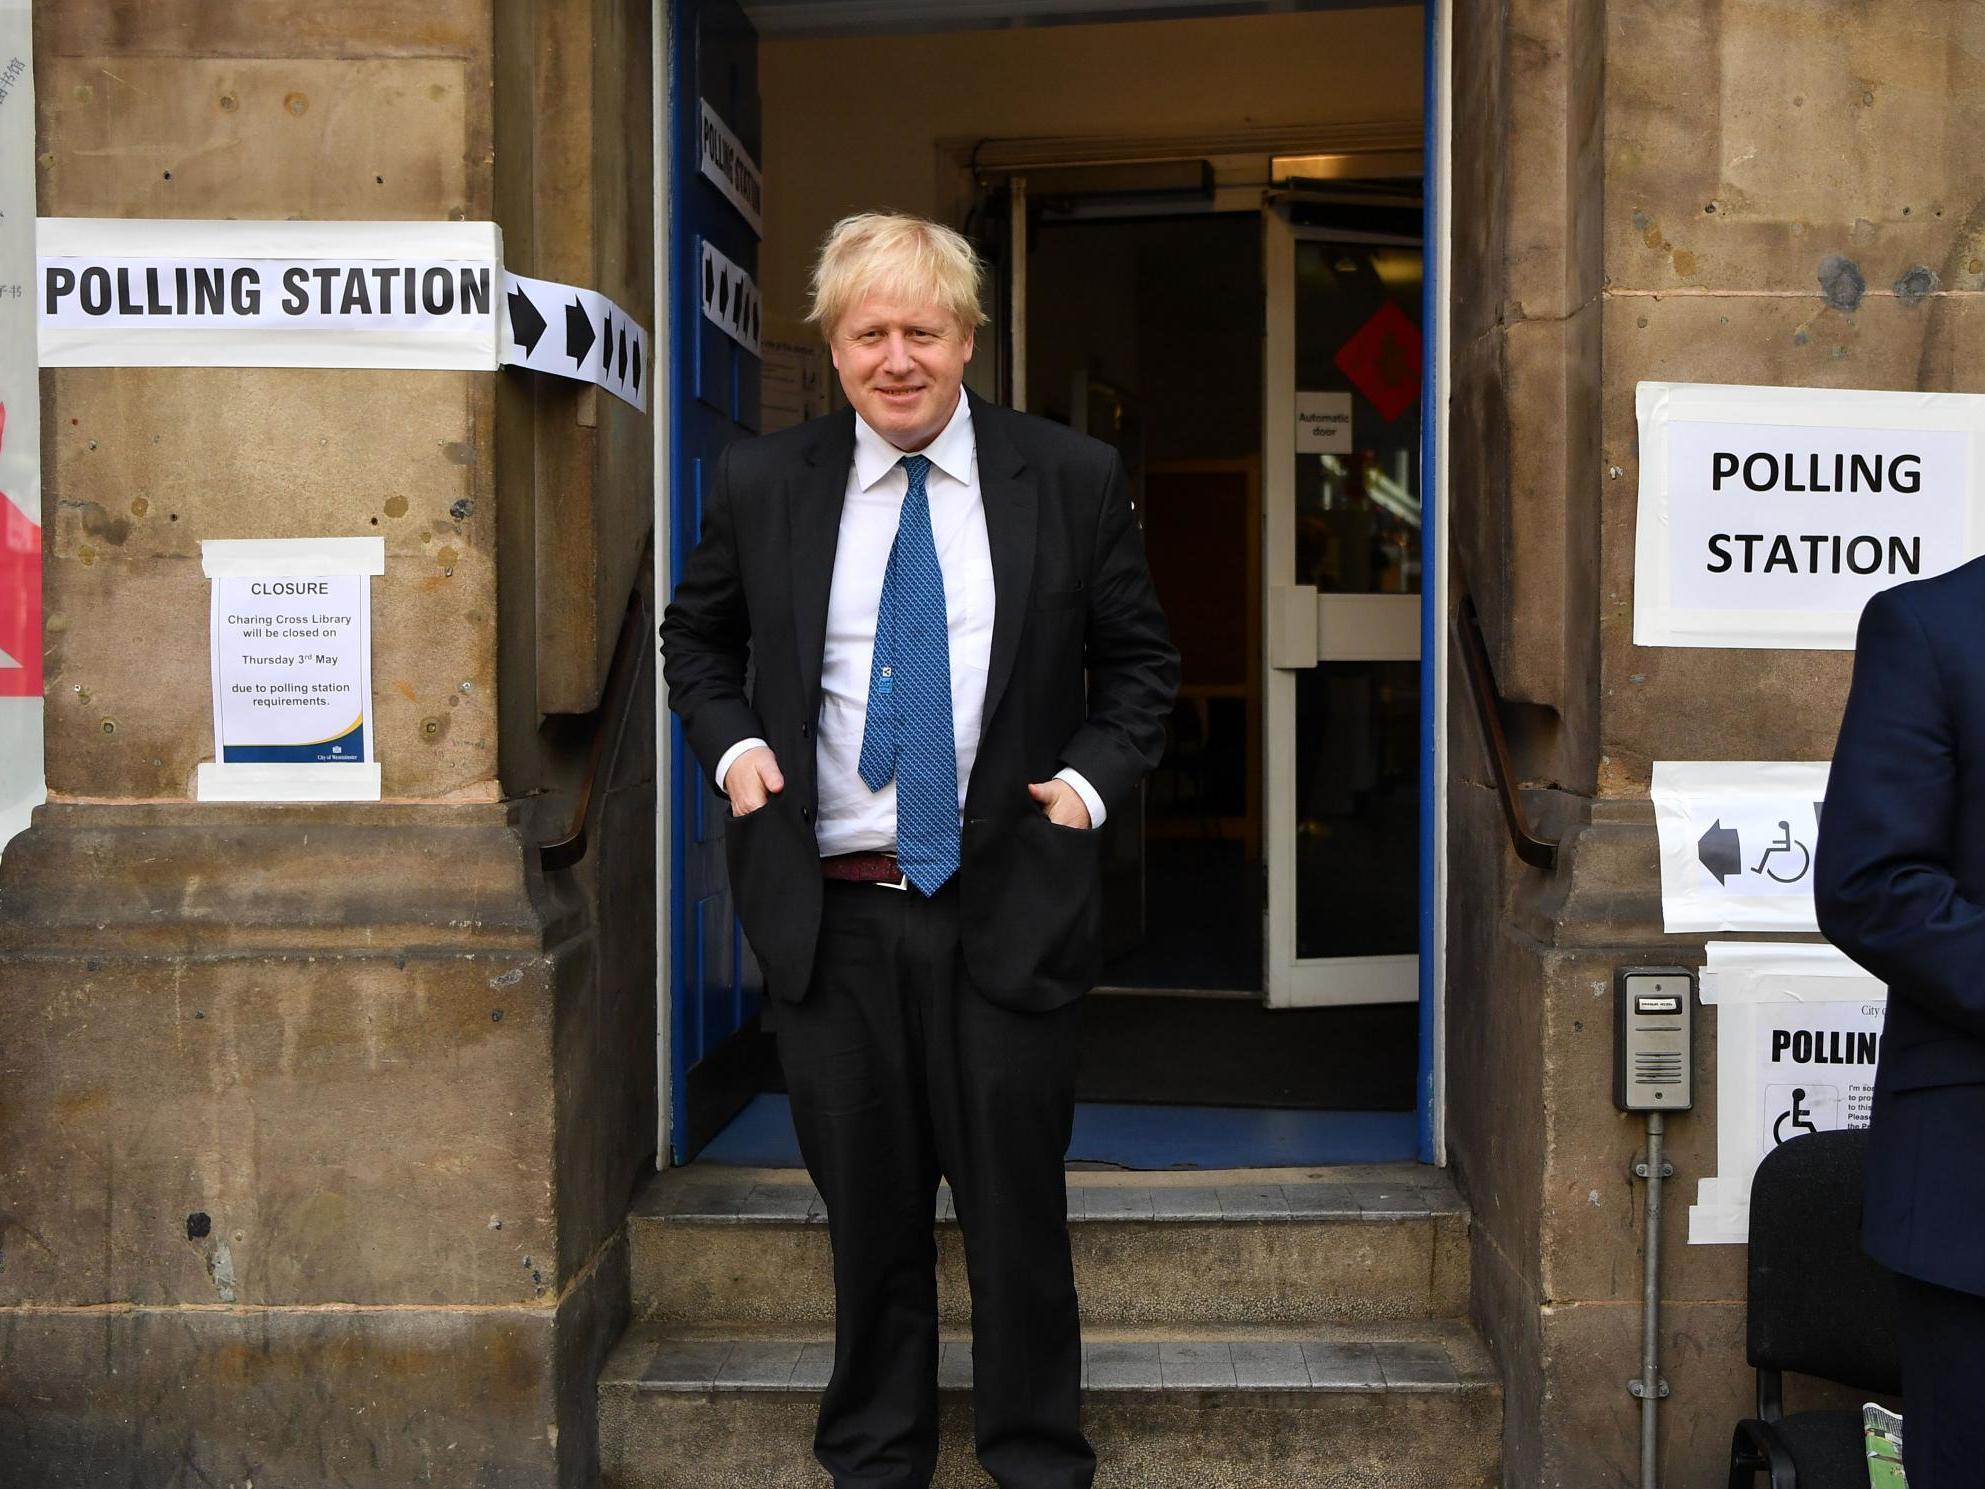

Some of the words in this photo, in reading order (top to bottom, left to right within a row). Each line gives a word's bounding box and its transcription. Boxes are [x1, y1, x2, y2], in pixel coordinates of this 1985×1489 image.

[703, 115, 734, 185] POLLING
[734, 157, 761, 216] STATION
[46, 266, 261, 316] POLLING
[281, 266, 490, 316] STATION
[1299, 413, 1350, 424] Automatic
[1313, 426, 1337, 437] door
[1712, 452, 1921, 494] POLLING
[1706, 533, 1921, 575] STATION
[251, 582, 329, 596] CLOSURE
[227, 614, 273, 627] Charing
[276, 614, 309, 624] Cross
[312, 614, 352, 626] Library
[243, 628, 262, 638] will
[265, 628, 279, 638] be
[282, 627, 319, 638] closed
[322, 629, 337, 638] on
[242, 655, 295, 667] Thursday
[298, 654, 313, 665] 3rd
[315, 655, 338, 667] May
[231, 683, 253, 693] due
[255, 684, 267, 693] to
[270, 683, 309, 695] polling
[311, 683, 350, 693] station
[252, 696, 330, 708] requirements.
[1861, 1004, 1880, 1018] City
[1771, 1029, 1880, 1065] POLLIN
[1848, 1084, 1860, 1092] I'm
